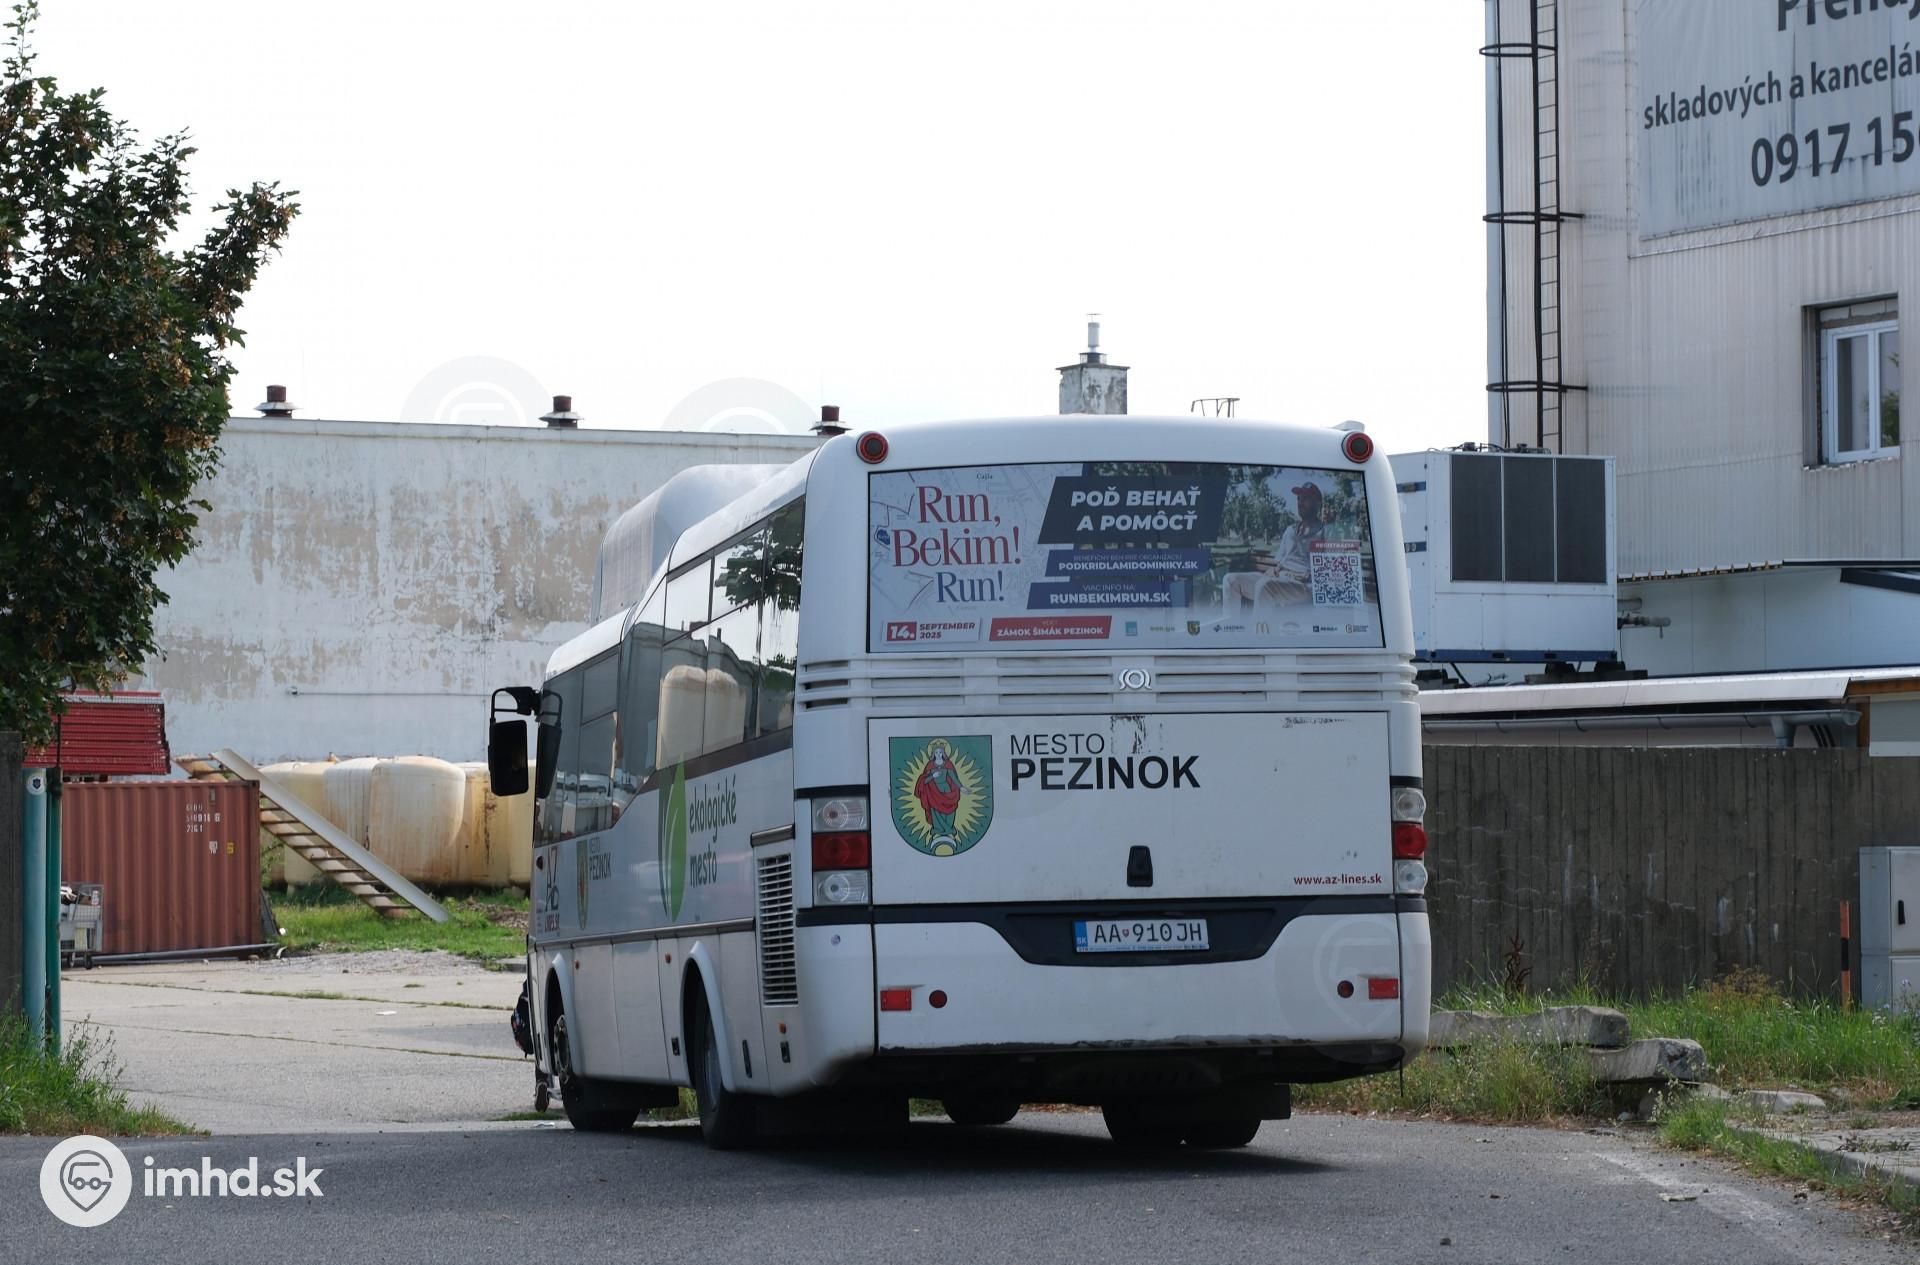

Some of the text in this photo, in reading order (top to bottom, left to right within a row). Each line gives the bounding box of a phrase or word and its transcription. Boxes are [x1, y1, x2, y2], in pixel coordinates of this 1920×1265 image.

[1644, 71, 1782, 130] skladových
[1789, 75, 1804, 99] a
[1751, 111, 1920, 187] 0917 15
[916, 485, 1001, 527] Run,
[1071, 486, 1201, 507] POĎ BEHAŤ
[1076, 510, 1198, 531] A POMÔCŤ
[891, 526, 1021, 567] Bekim!
[1058, 560, 1199, 571] PODKRIDLAMIDOMINIKY.SK
[936, 570, 1005, 603] Run!
[1050, 592, 1171, 604] RUNBEKIMRUN.SK
[890, 622, 975, 640] 14. SEPTEMBER
[919, 631, 942, 640] 2025
[997, 627, 1032, 637] ZÁMOK
[1064, 627, 1103, 635] PEZINOK
[1010, 733, 1105, 755] MESTO
[1011, 755, 1201, 791] PEZINOK
[690, 773, 737, 842] ekologické
[690, 843, 717, 888] mesto
[1293, 873, 1382, 885] www.az-lines.sk
